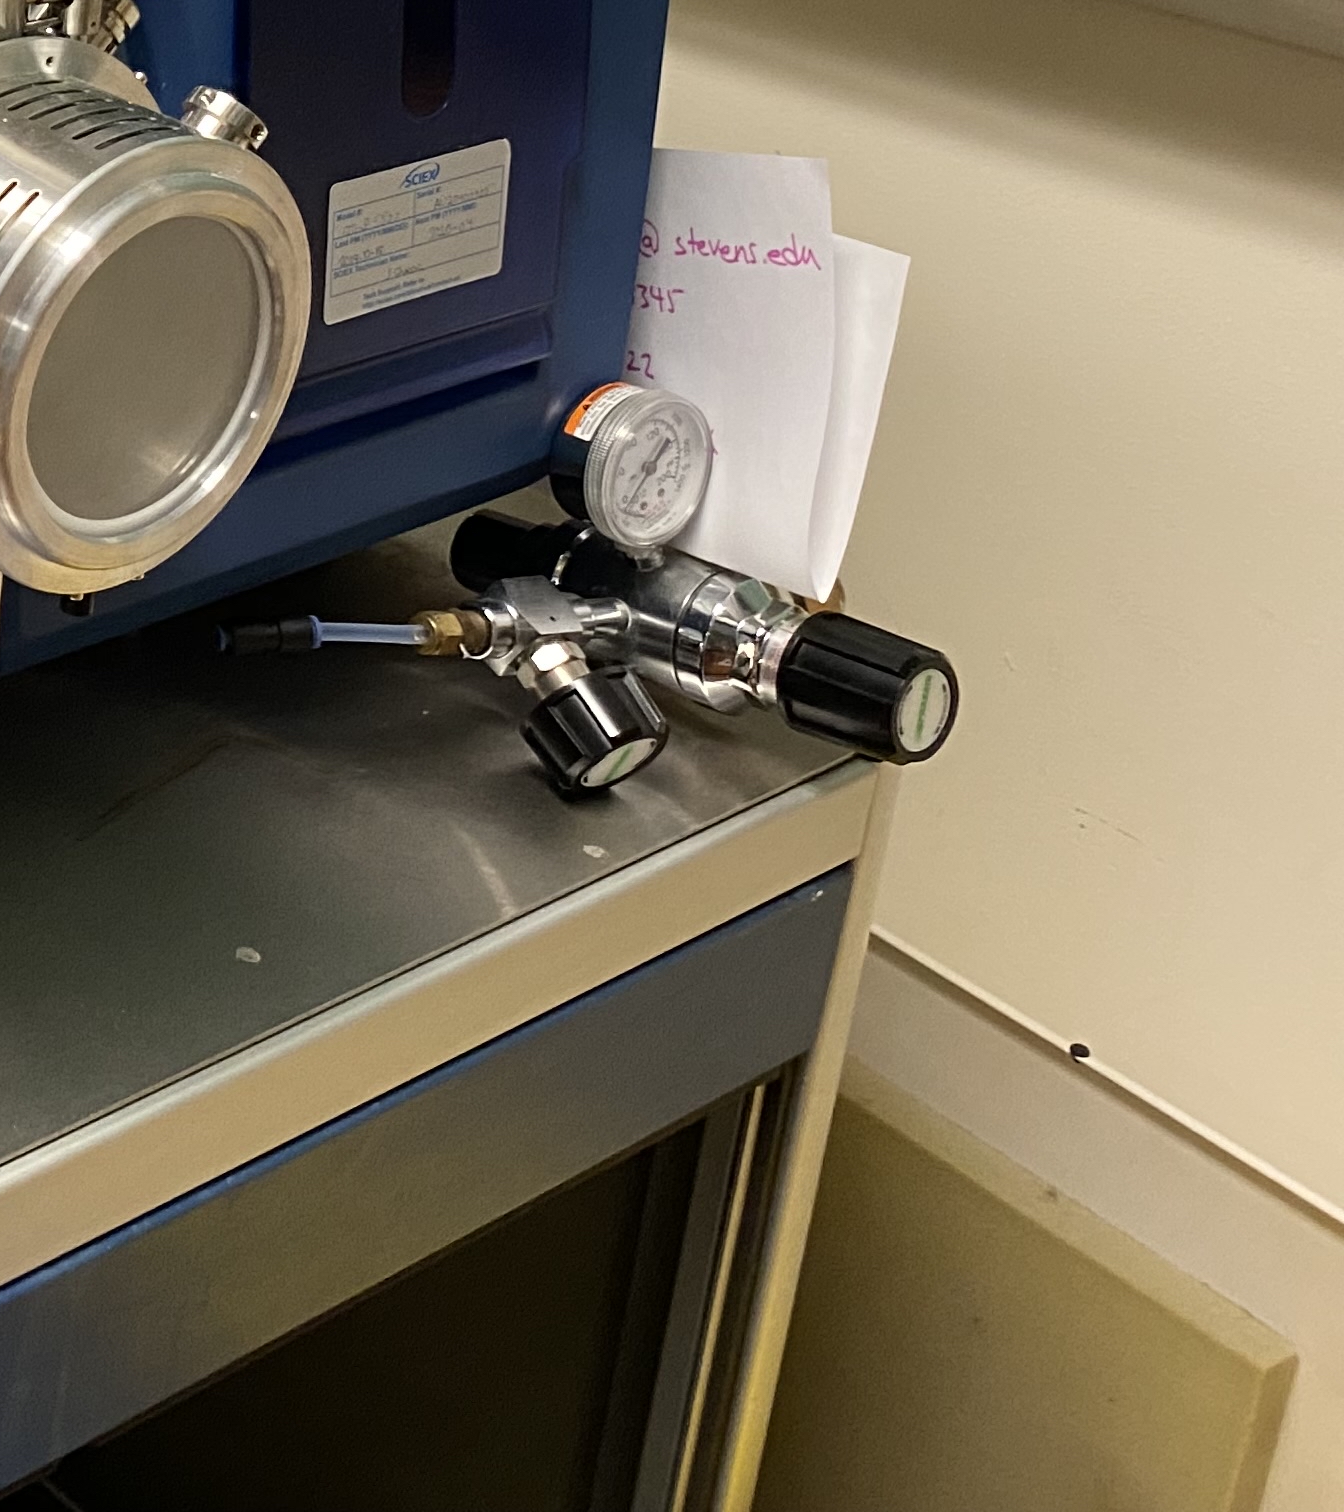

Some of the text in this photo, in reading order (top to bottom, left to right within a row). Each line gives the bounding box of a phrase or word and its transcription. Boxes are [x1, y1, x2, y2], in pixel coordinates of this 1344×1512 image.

[404, 168, 436, 188] SCIEX
[675, 227, 822, 271] stevens.edu
[636, 284, 684, 314] 345
[626, 350, 654, 379] 22
